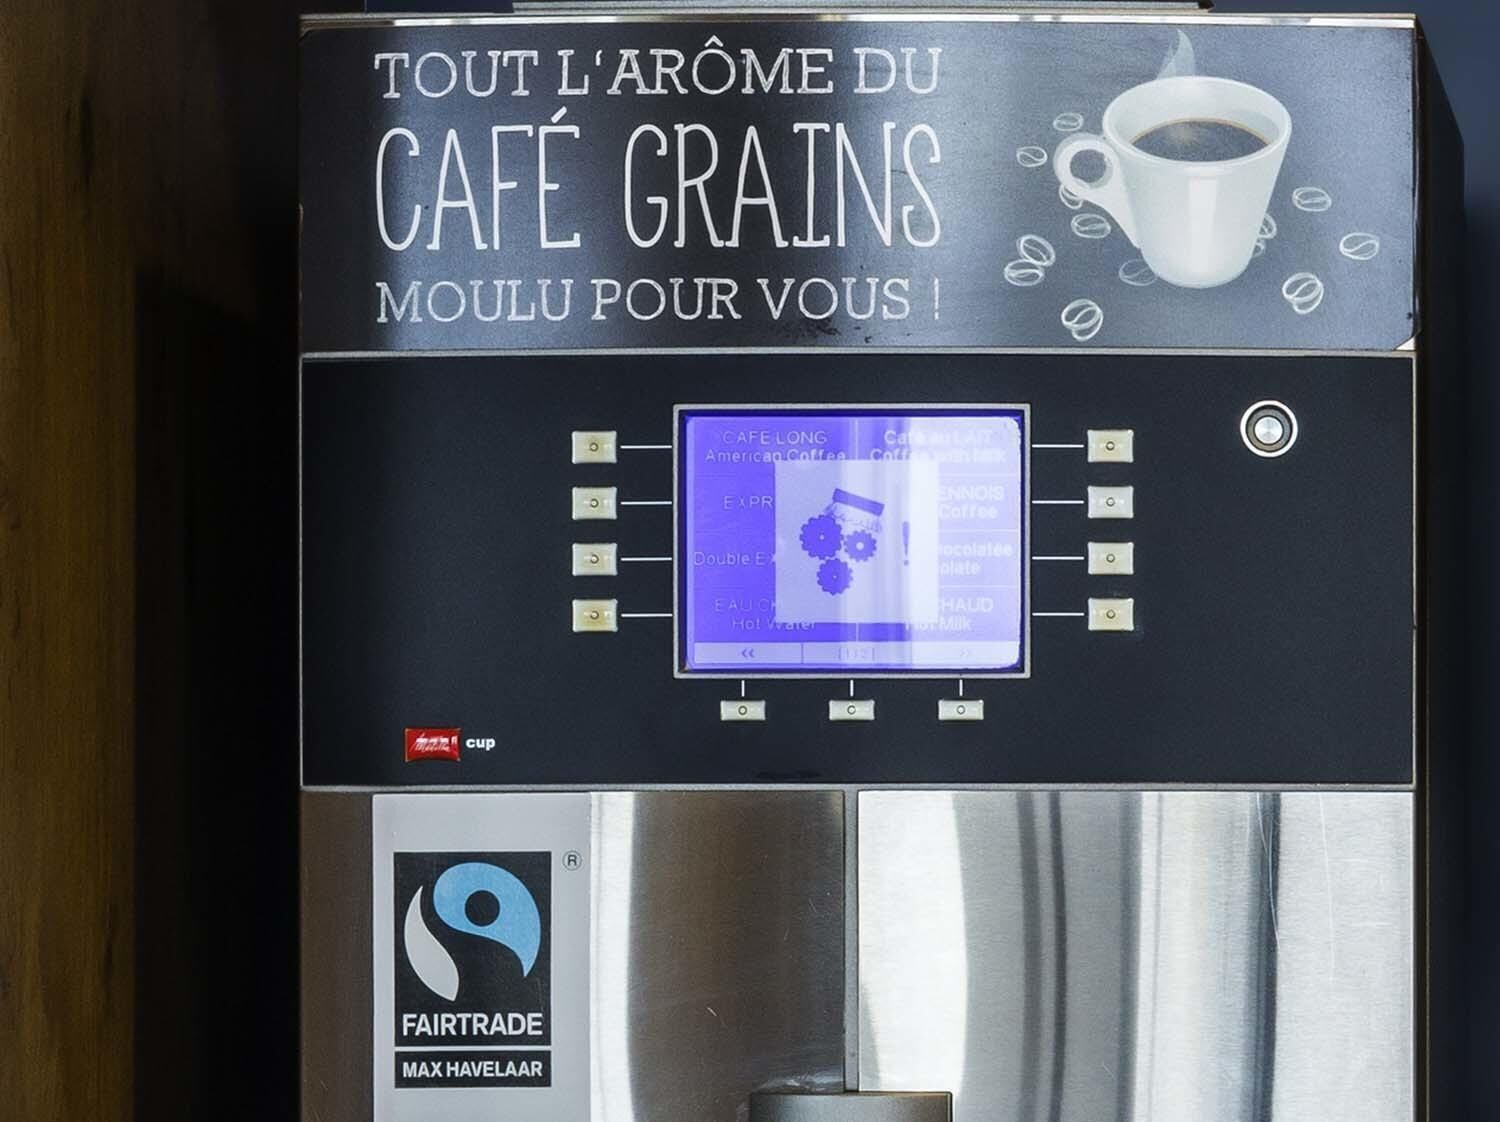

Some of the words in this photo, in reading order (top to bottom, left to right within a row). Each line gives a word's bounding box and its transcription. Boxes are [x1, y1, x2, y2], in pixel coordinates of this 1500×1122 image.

[374, 50, 539, 99] TOUT
[557, 35, 834, 96] L'ARÔME
[854, 47, 942, 96] DU
[376, 106, 582, 252] CAFÉ
[624, 121, 942, 249] GRAINS
[376, 279, 573, 324] MOULU
[591, 277, 742, 323] POUR
[757, 276, 911, 322] VOUS
[722, 430, 771, 445] CAFE
[776, 430, 828, 445] LONG
[705, 449, 782, 463] American
[787, 449, 846, 461] Coffee
[724, 495, 774, 510] EXPR
[694, 551, 751, 566] Double
[714, 598, 753, 612] EAU
[941, 597, 995, 613] HAUD
[732, 617, 761, 631] Hot
[465, 738, 496, 751] cup
[402, 1013, 543, 1037] FAIRTRADE
[402, 1061, 442, 1078] MAX
[446, 1060, 543, 1078] HAVELAAR
